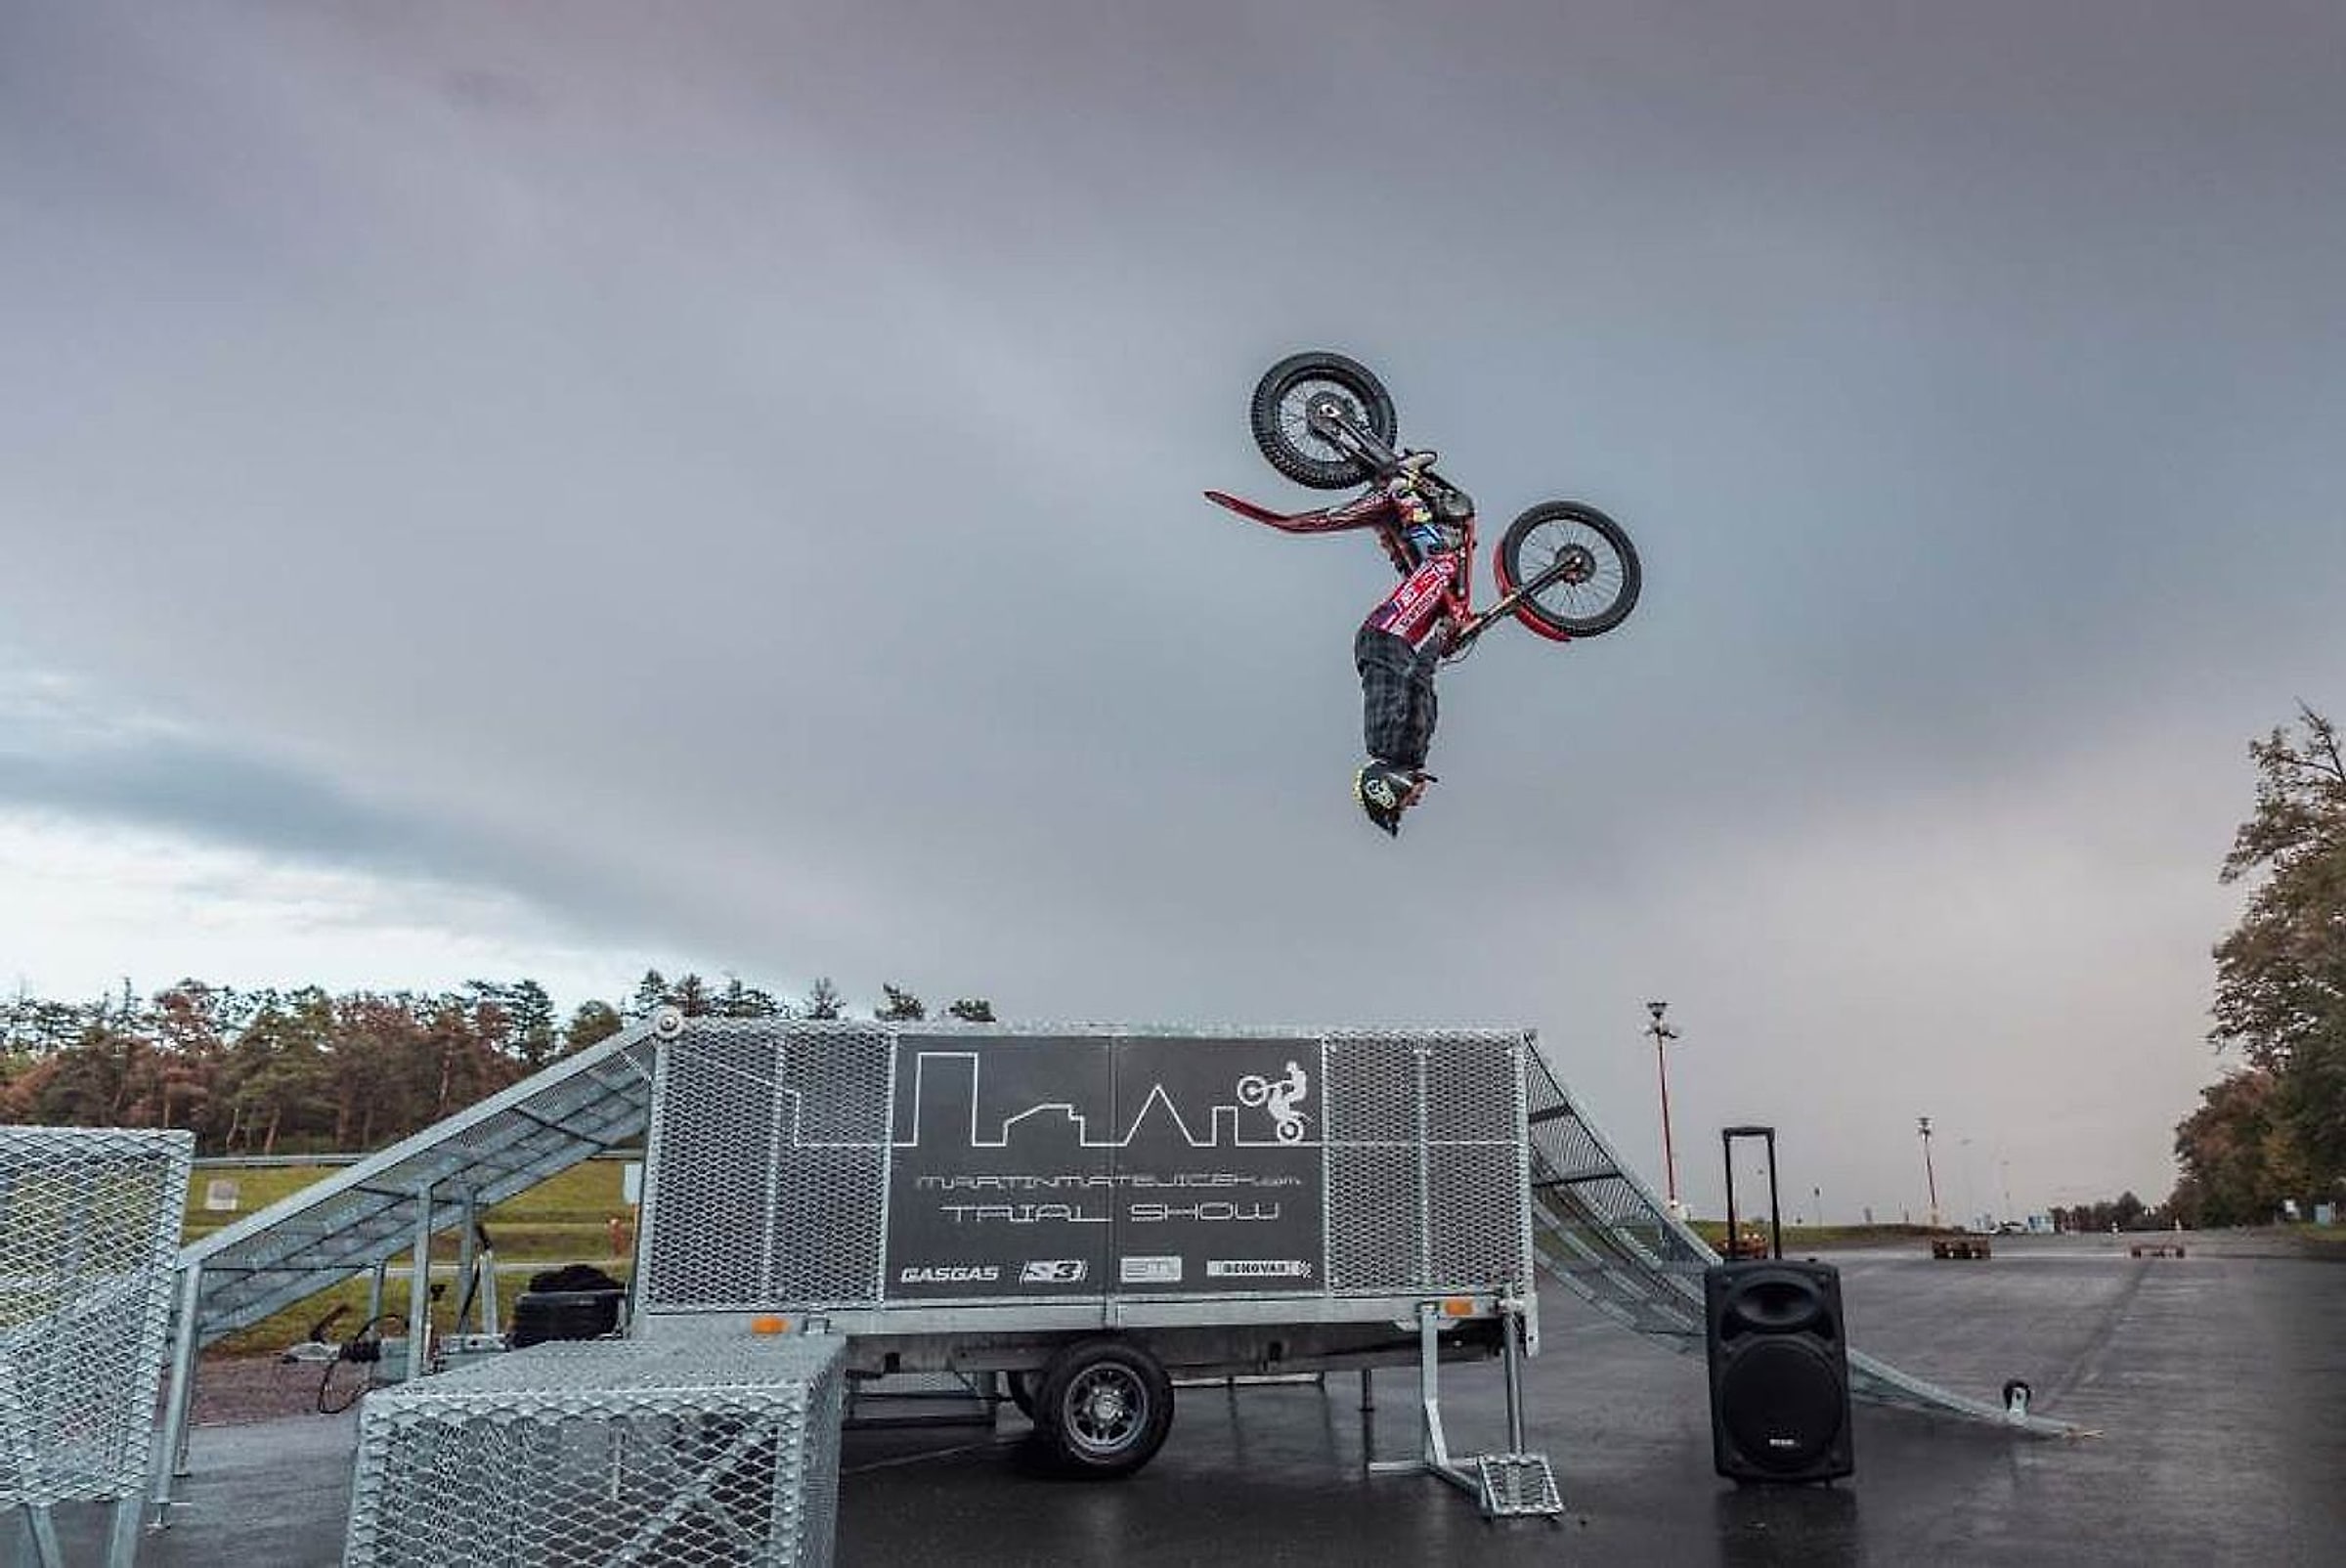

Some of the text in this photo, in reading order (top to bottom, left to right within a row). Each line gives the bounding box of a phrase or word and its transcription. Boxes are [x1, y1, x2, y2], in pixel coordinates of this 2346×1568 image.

[939, 1202, 1280, 1222] TRIAL SHOW
[900, 1267, 999, 1284] GASGAS
